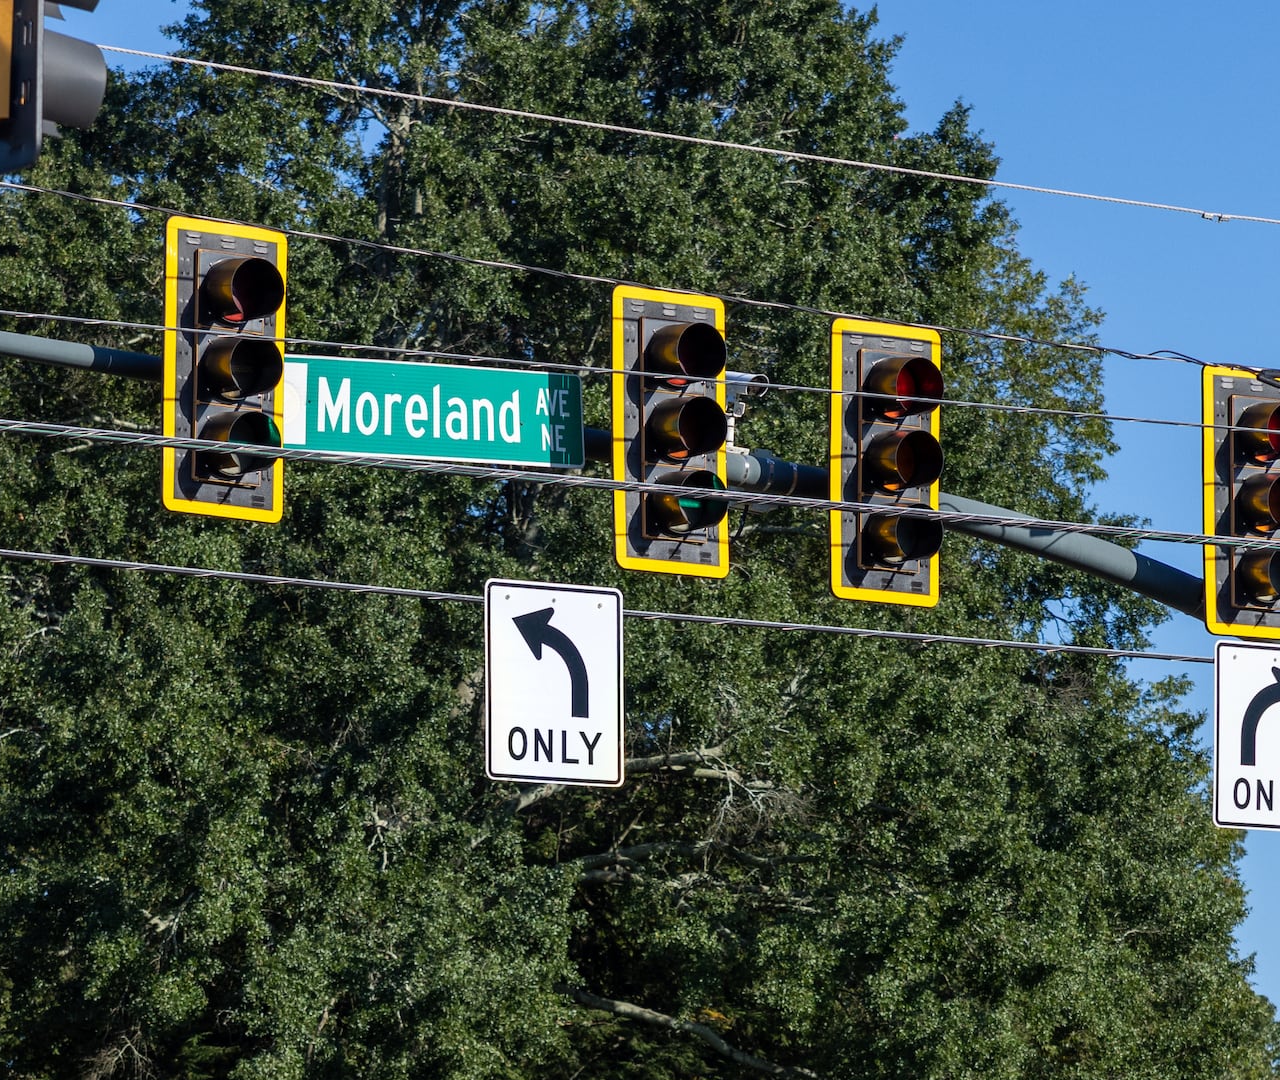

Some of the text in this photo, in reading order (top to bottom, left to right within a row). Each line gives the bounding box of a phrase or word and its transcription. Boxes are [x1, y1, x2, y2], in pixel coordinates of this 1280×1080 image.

[317, 376, 521, 444] Moreland
[535, 387, 571, 417] AVE
[540, 424, 567, 453] NE
[508, 726, 603, 766] ONLY
